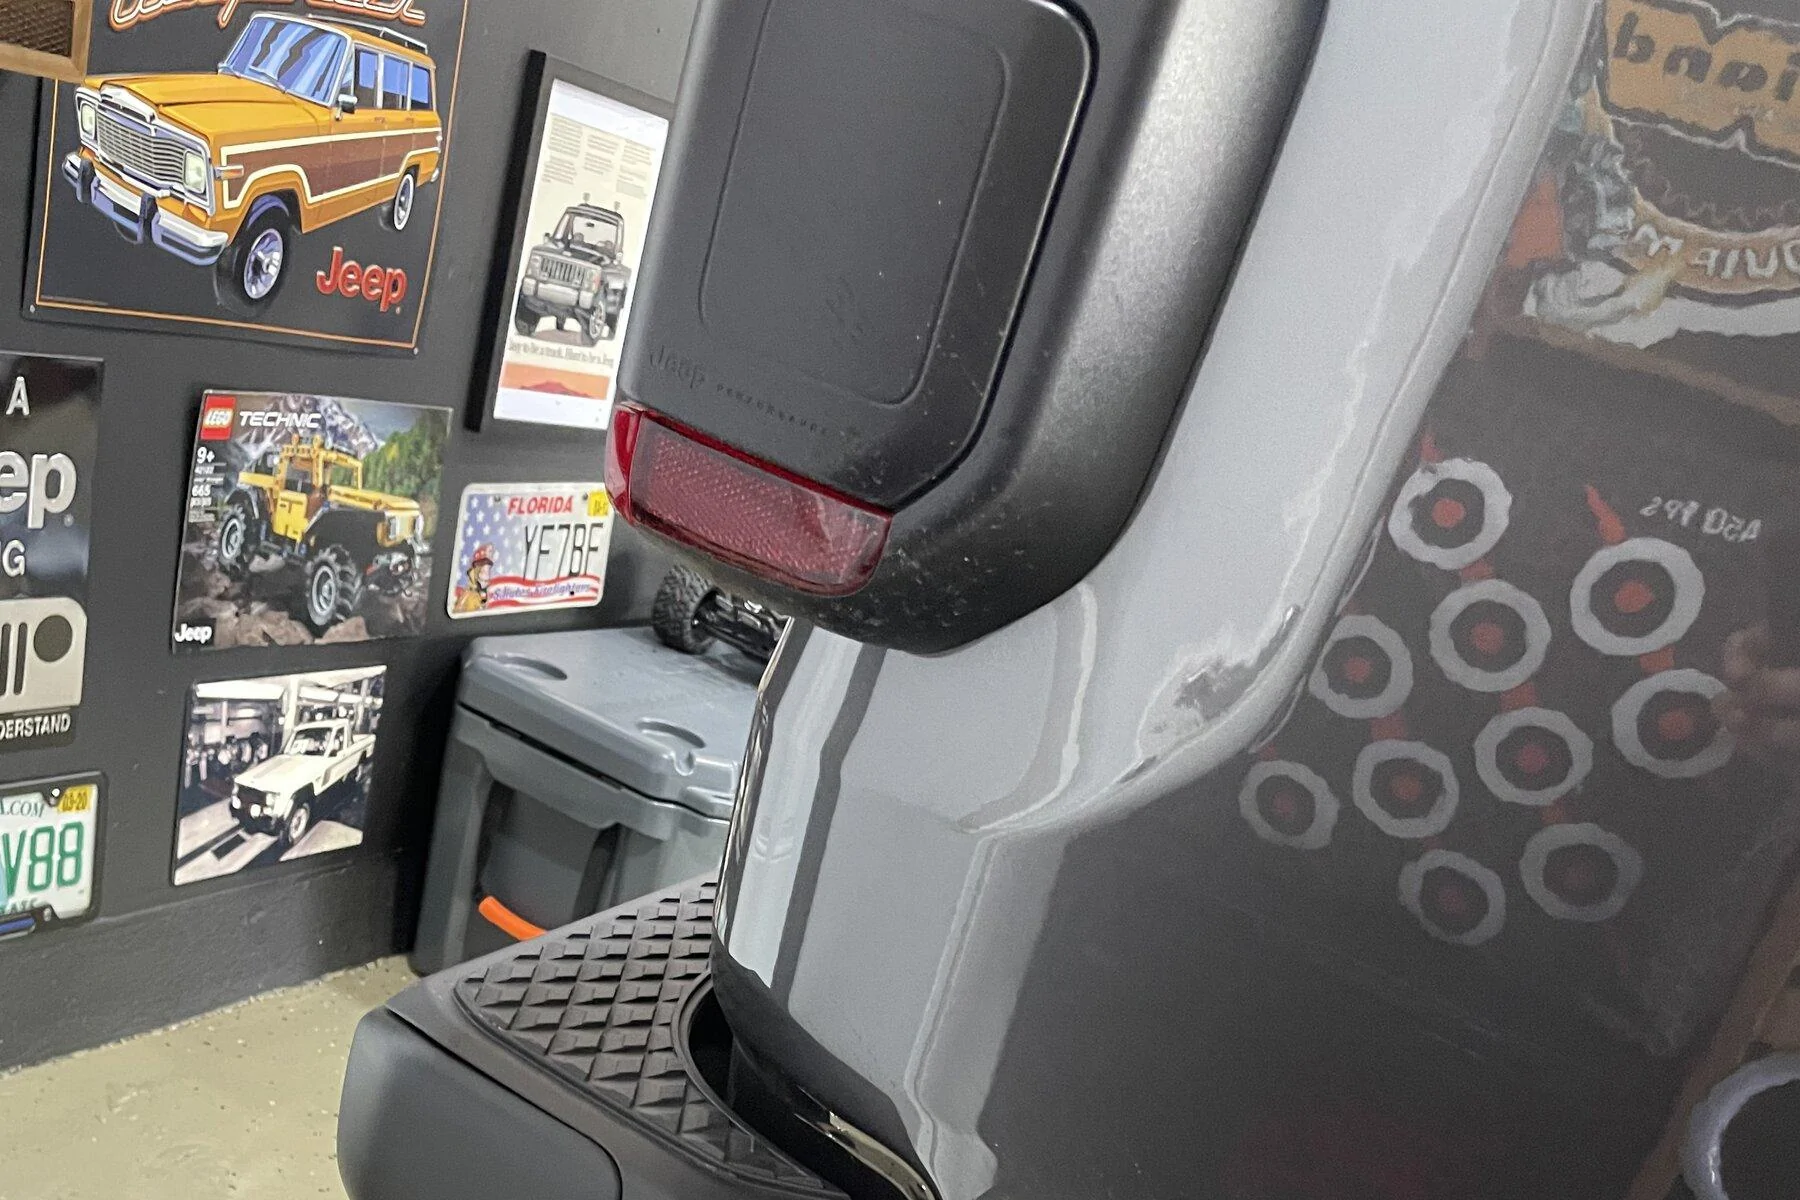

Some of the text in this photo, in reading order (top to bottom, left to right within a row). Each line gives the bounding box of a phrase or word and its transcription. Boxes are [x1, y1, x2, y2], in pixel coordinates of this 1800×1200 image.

[316, 245, 407, 312] Jeep
[204, 408, 233, 427] LEGO
[239, 411, 322, 429] TECHNIC
[196, 446, 216, 464] 9+
[507, 495, 574, 515] FLORIDA
[174, 622, 213, 645] Jeep
